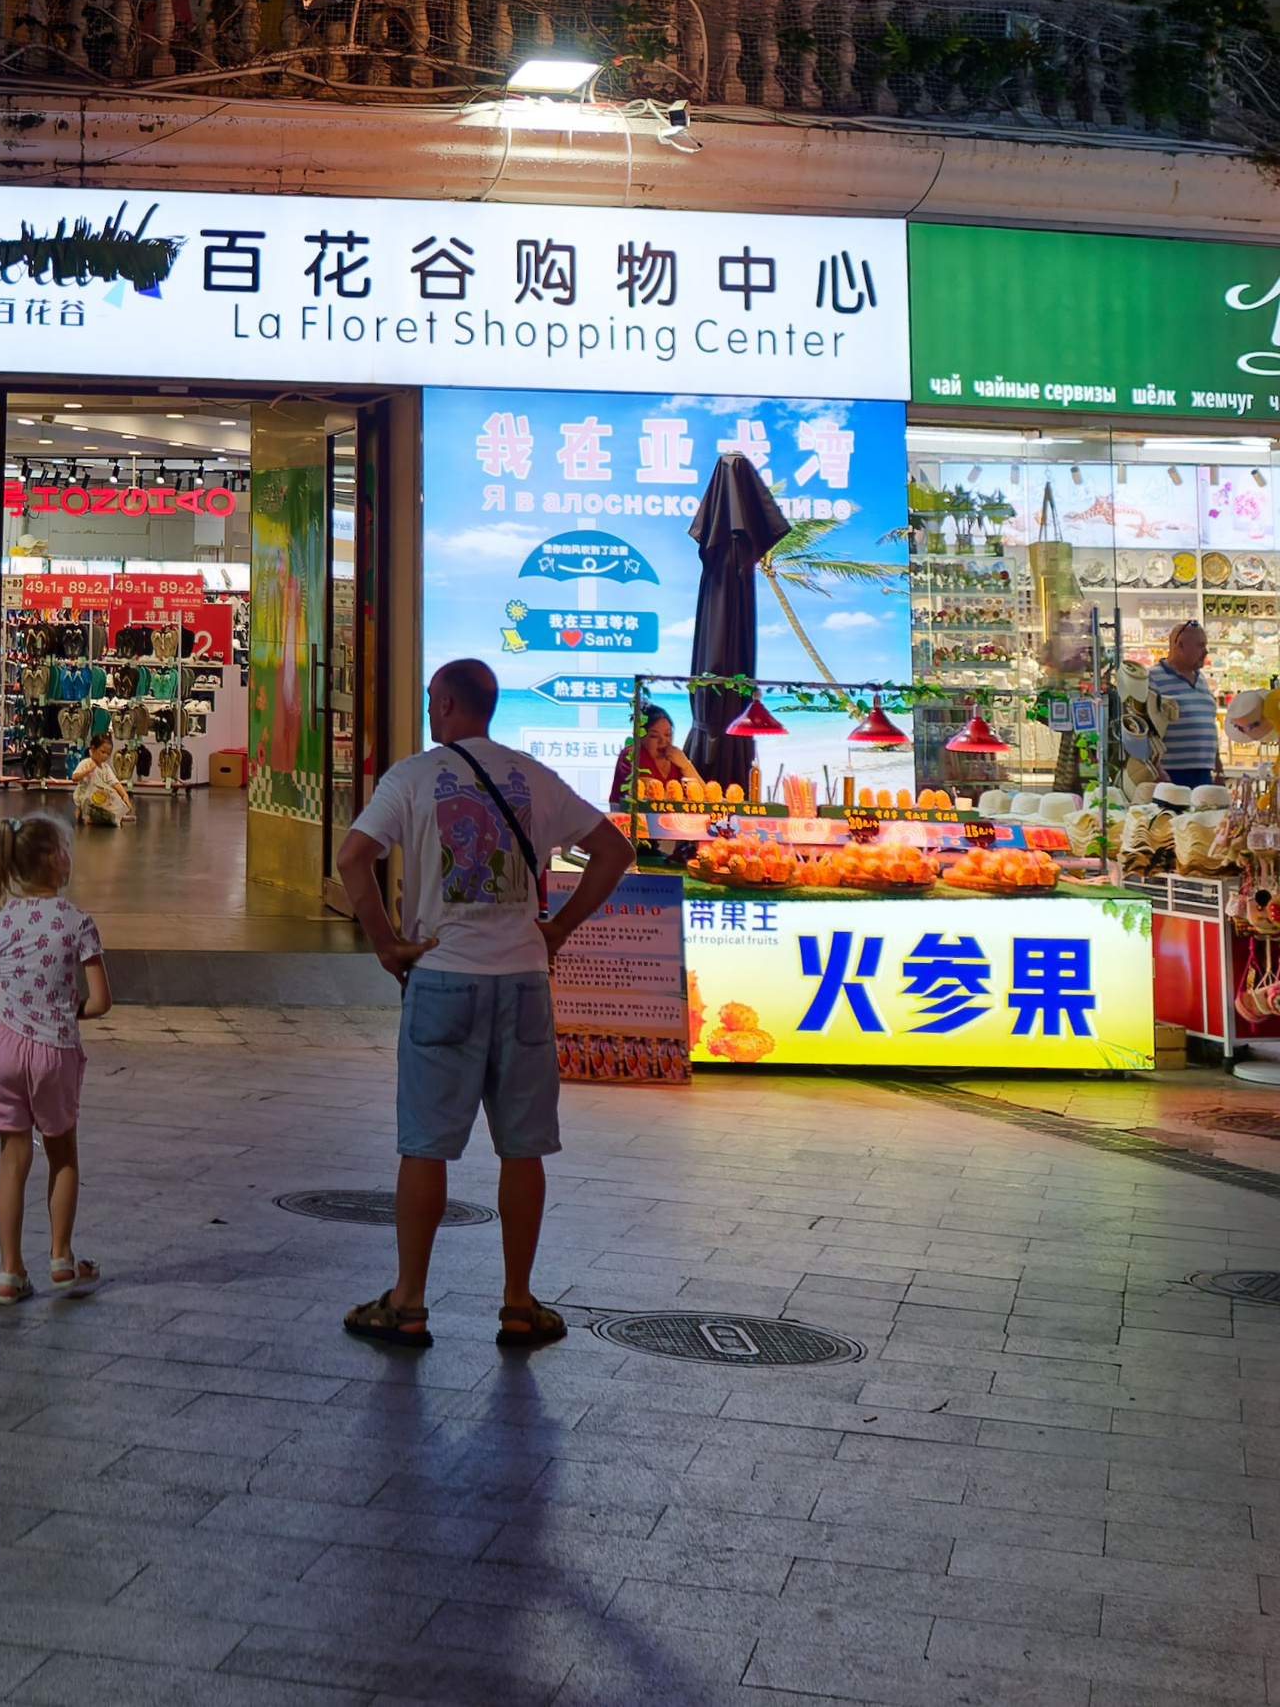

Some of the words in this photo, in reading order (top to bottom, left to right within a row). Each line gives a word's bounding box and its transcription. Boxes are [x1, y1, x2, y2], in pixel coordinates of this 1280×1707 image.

[200, 229, 877, 314] 百花谷购物中心
[234, 304, 280, 339] La
[302, 304, 437, 344] Floret
[455, 309, 676, 361] Shopping
[695, 319, 845, 357] Center
[931, 376, 962, 396] чай
[974, 378, 1040, 399] чайные
[1045, 384, 1117, 406] сервизы
[1132, 384, 1177, 406] шёлк
[1191, 391, 1254, 415] жемчуг
[482, 485, 506, 512] Я
[515, 492, 534, 512] в
[543, 493, 701, 517] алоснско
[542, 544, 629, 557] 想你的风吹到了这里
[549, 614, 639, 630] 我在三亚等你
[585, 632, 632, 647] SanYa
[554, 681, 617, 698] 热爱生活
[530, 741, 598, 757] 前方好运
[604, 903, 661, 916] вано
[700, 935, 745, 947] tropical
[747, 935, 779, 946] fruits
[796, 931, 1097, 1037] 火参果
